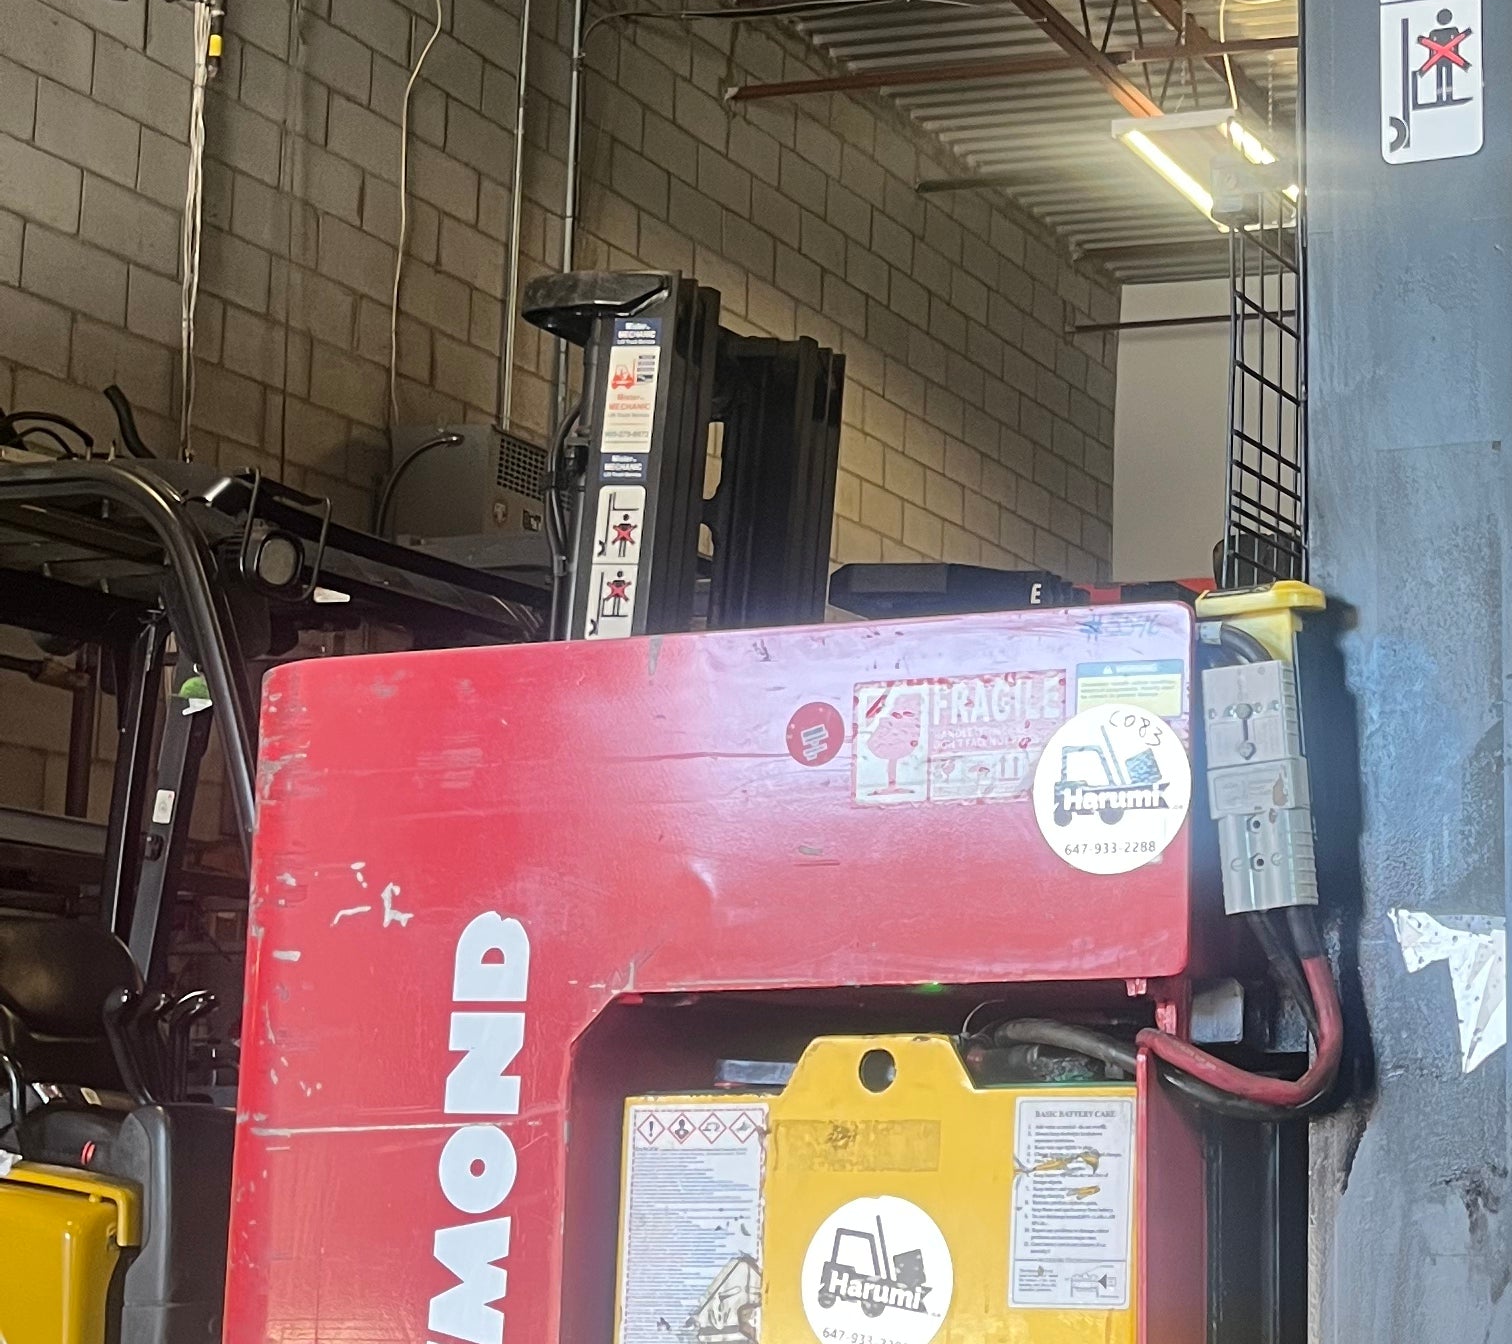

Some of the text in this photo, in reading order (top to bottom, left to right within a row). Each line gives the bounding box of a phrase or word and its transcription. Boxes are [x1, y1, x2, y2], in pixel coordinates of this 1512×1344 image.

[933, 674, 1062, 725] FRAGILE
[1063, 782, 1161, 811] Harumi
[1064, 840, 1156, 856] 647-933-2288
[1035, 1110, 1116, 1118] BASIC BATTERY CARE
[828, 1269, 924, 1311] Harumi
